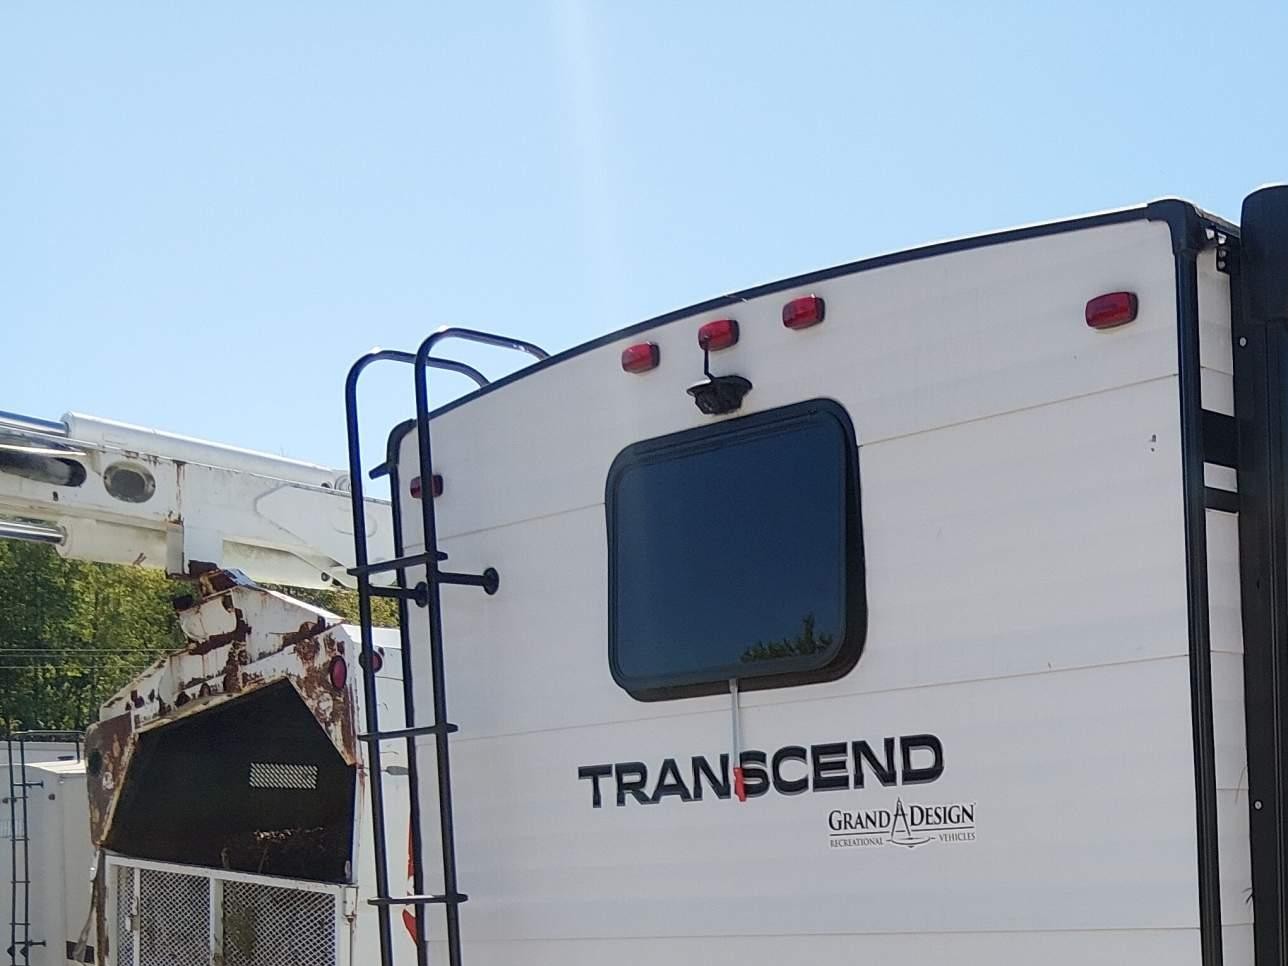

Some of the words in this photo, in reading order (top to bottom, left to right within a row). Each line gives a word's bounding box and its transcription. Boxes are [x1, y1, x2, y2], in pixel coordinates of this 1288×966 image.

[578, 733, 945, 808] TRANSCEND
[828, 809, 891, 831] GRAND
[909, 804, 976, 827] DESIGN
[830, 837, 884, 848] RECREATIONAL
[938, 831, 976, 842] VEHICLES
